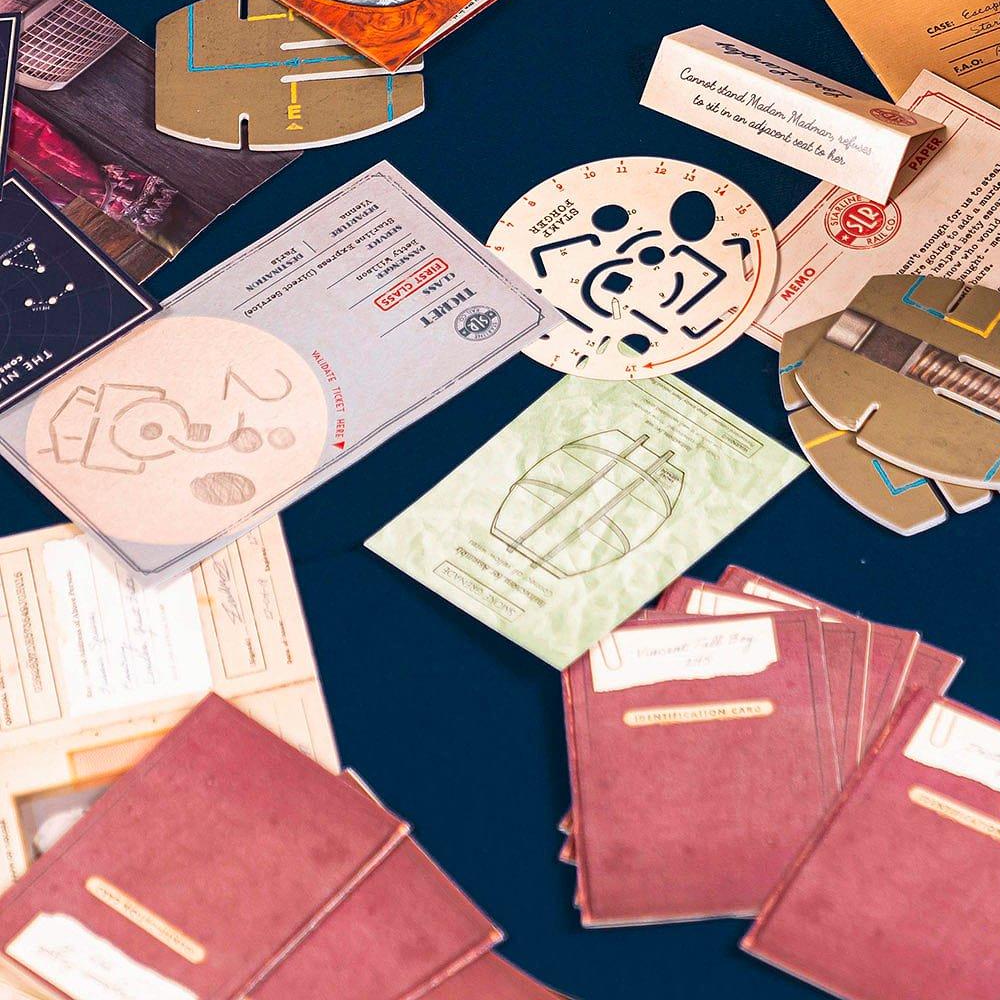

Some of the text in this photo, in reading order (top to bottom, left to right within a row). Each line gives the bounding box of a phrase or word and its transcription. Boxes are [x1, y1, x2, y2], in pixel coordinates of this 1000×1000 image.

[926, 19, 955, 35] CASE:
[678, 65, 718, 92] Cannot
[715, 81, 748, 104] stand
[745, 92, 789, 120] Madam
[786, 109, 837, 142] Madman,
[835, 129, 874, 157] refuses
[691, 93, 848, 166] to sit in an adjacent seat to her
[908, 135, 942, 172] PAPER
[583, 171, 596, 179] 10
[683, 173, 695, 181] 13
[714, 186, 725, 195] 14
[327, 202, 378, 239] DEPARTURE
[338, 197, 372, 223] Vienna
[528, 198, 574, 234] FORGER
[543, 207, 579, 237] STAMP
[735, 204, 746, 214] 15
[830, 194, 861, 226] STARLINE
[845, 206, 878, 232] SLR
[918, 221, 948, 254] enough
[945, 206, 962, 224] for
[960, 195, 972, 209] us
[969, 184, 982, 198] to
[364, 223, 403, 252] SERVICE
[390, 236, 418, 259] Betty
[866, 231, 887, 244] RAIL
[923, 238, 949, 266] going
[944, 226, 958, 240] to
[955, 211, 972, 230] add
[971, 205, 980, 214] a
[931, 242, 962, 275] helped
[958, 217, 984, 246] Betty
[959, 241, 978, 261] who
[975, 215, 1000, 244] would
[242, 215, 394, 320] Starline Express (Direct Service)
[244, 251, 303, 293] DESTINATION
[269, 246, 297, 268] Paris
[374, 243, 425, 280] PASSENGER
[378, 260, 441, 308] FIRST CLASS
[420, 270, 455, 296] CLASS
[779, 265, 816, 302] MEMO
[417, 283, 477, 328] TICKET
[466, 315, 488, 331] SLR
[22, 350, 52, 371] THE
[312, 350, 344, 437] VALIDATE TICKET HERE
